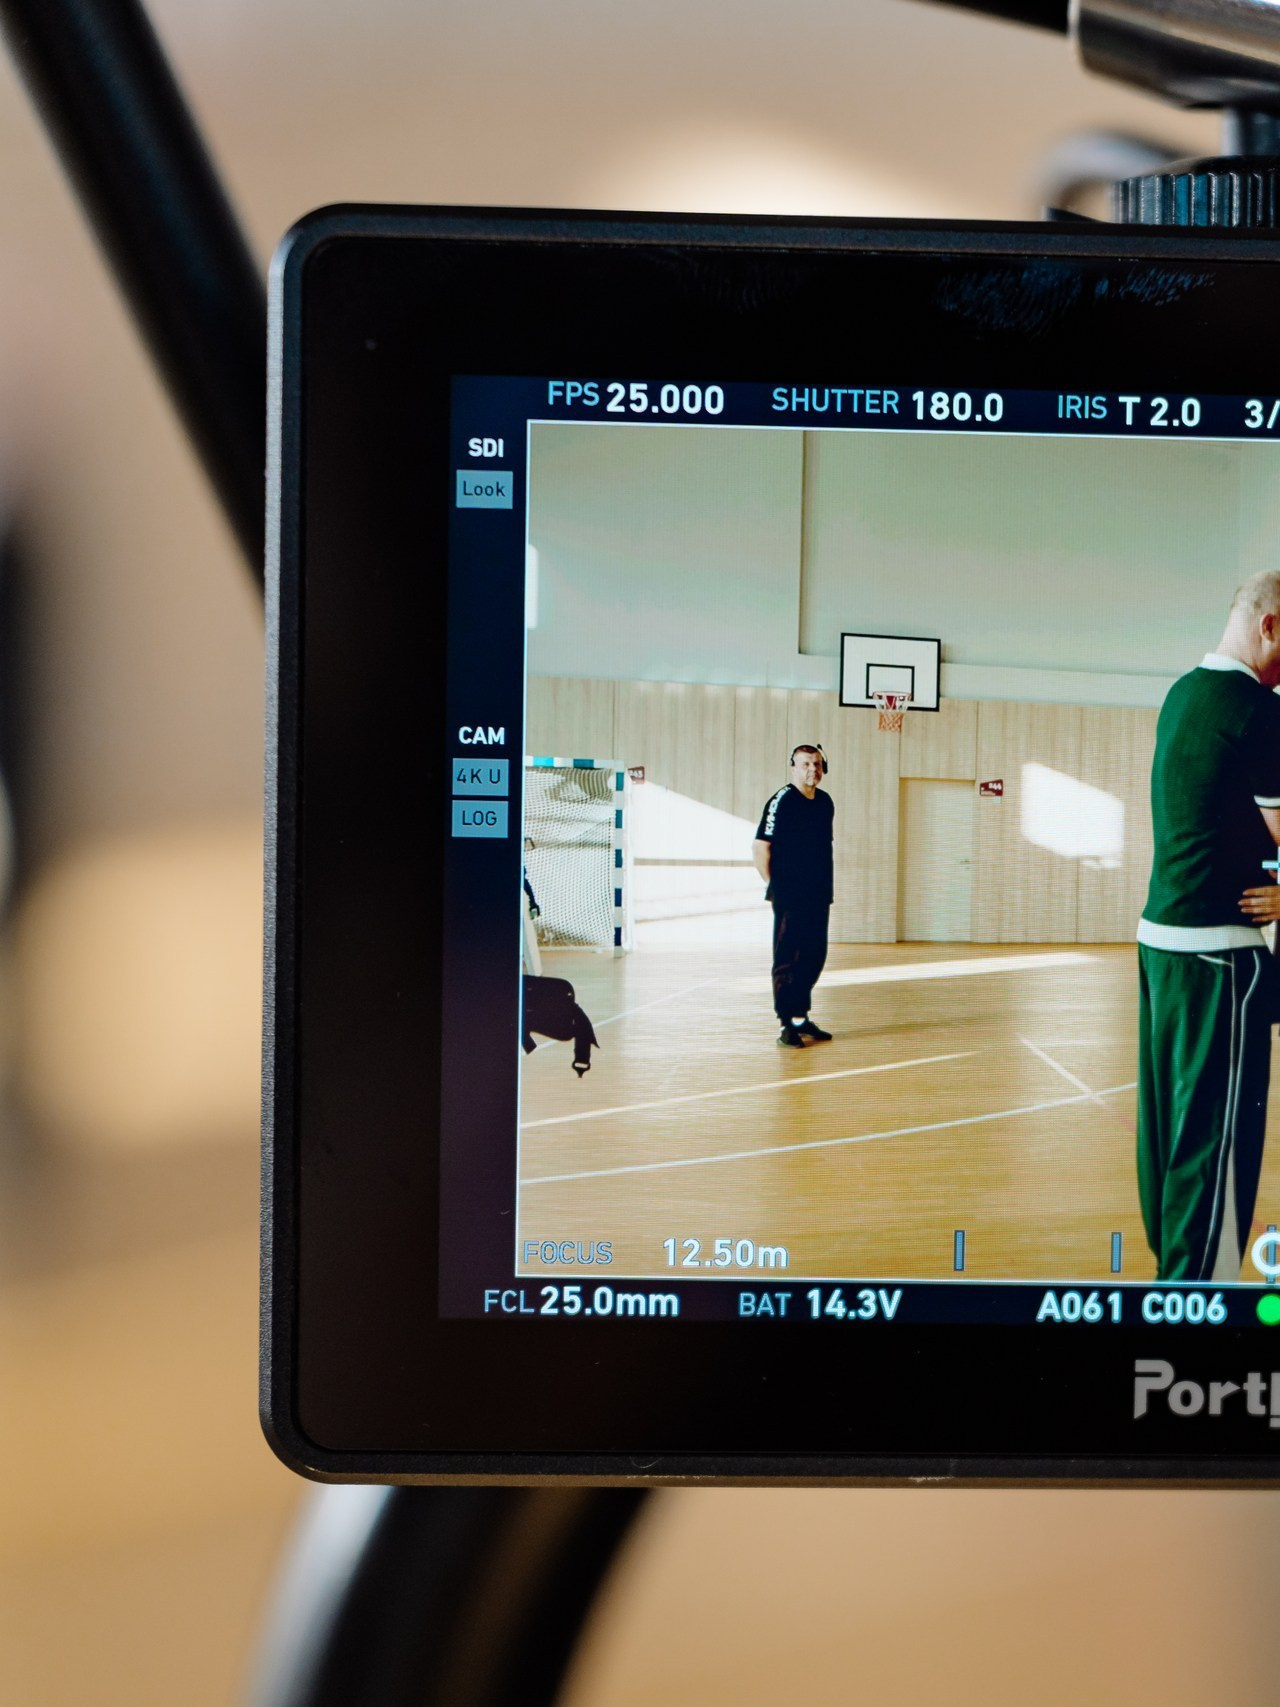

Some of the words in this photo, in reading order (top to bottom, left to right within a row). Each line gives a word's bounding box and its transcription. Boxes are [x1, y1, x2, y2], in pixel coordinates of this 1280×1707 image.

[547, 381, 600, 406] FPS
[606, 383, 725, 415] 25.000
[771, 387, 899, 414] SHUTTER
[911, 391, 1003, 422] 180.0
[1057, 395, 1107, 420] IRIS
[1119, 397, 1141, 426] T
[1149, 398, 1201, 427] 2.0
[468, 438, 504, 457] SDI
[463, 480, 506, 496] Look
[458, 727, 505, 744] CAM
[456, 769, 482, 784] 4K
[489, 769, 501, 784] U
[461, 810, 497, 826] LOG
[523, 1241, 612, 1264] FOCUS
[663, 1238, 789, 1268] 12.50m
[484, 1290, 535, 1313] FCL
[540, 1286, 679, 1316] 25.0mm
[739, 1293, 792, 1316] BAT
[807, 1289, 902, 1319] 14.3V
[1036, 1290, 1122, 1323] A061
[1142, 1292, 1227, 1324] C006
